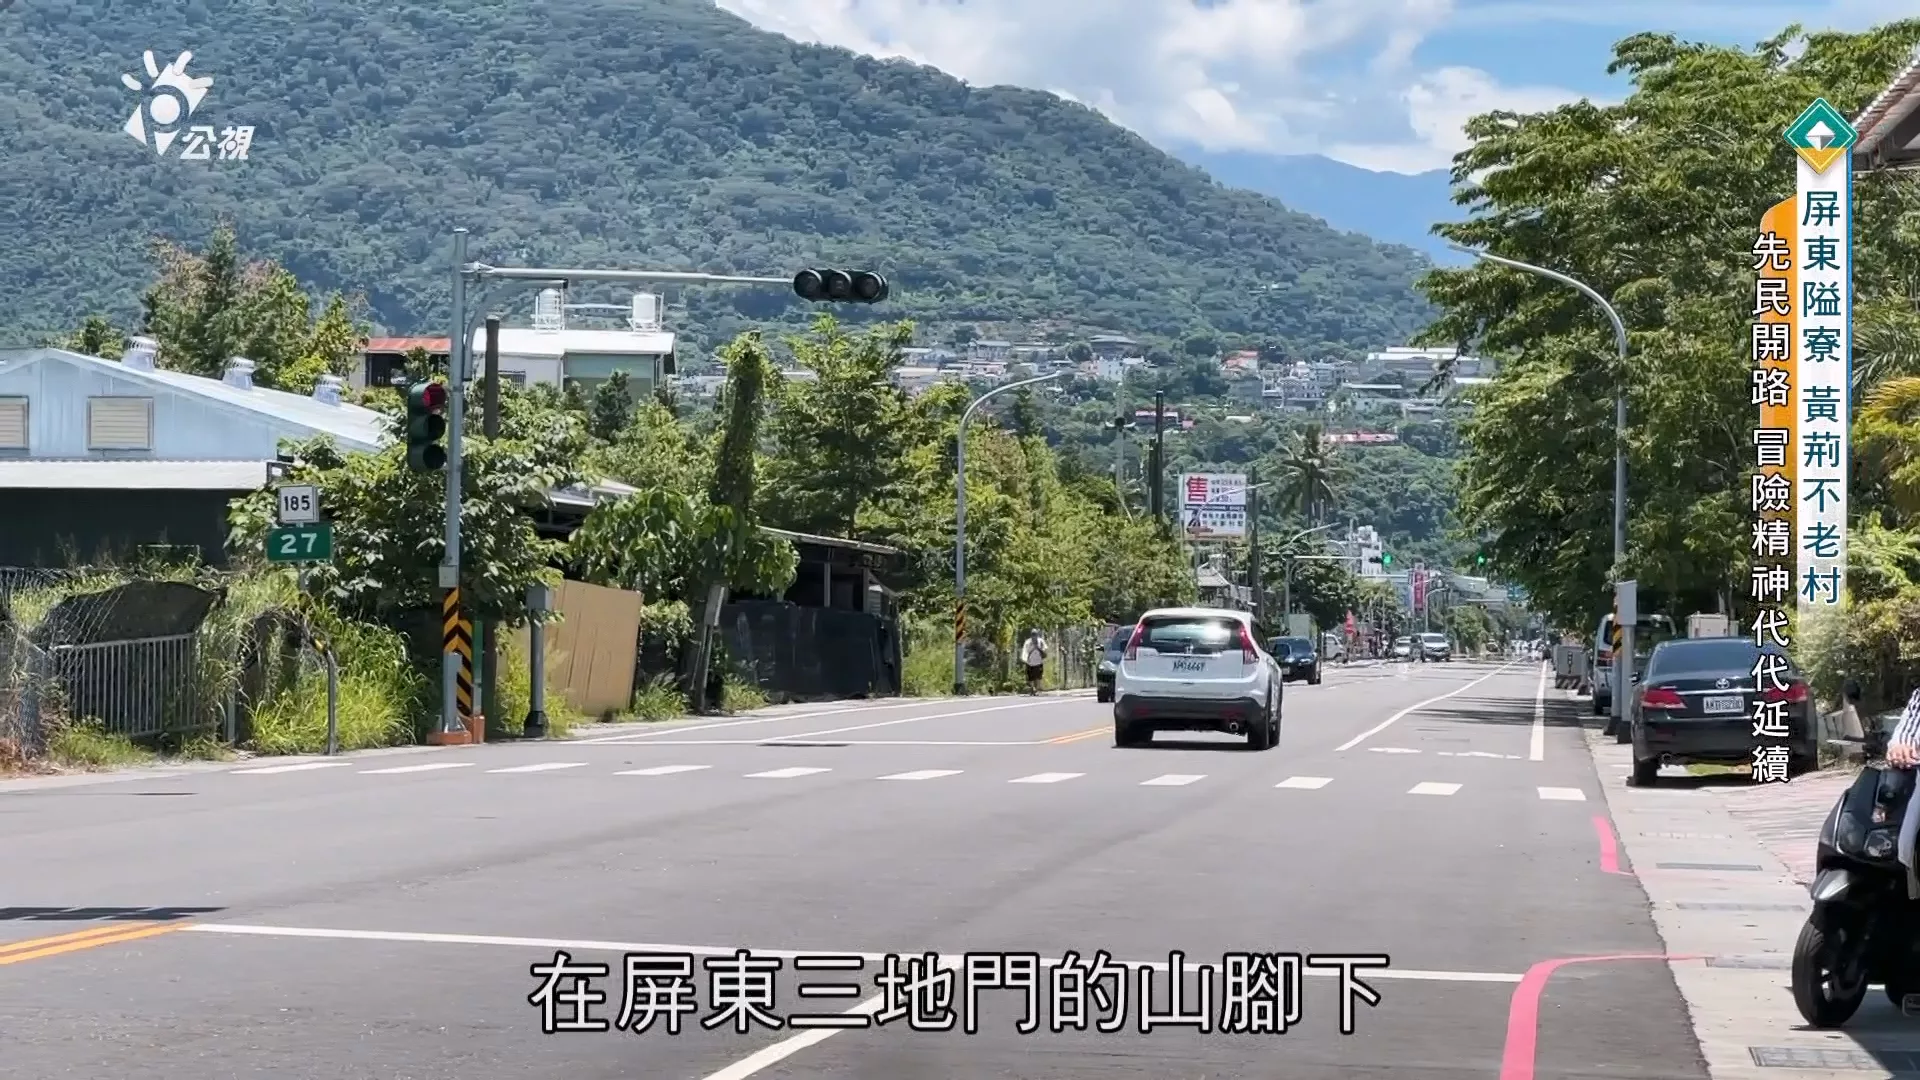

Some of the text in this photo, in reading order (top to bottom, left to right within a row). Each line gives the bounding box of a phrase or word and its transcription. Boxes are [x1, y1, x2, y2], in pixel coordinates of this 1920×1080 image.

[1186, 475, 1209, 503] 售
[283, 494, 311, 512] 185
[280, 532, 318, 554] 27
